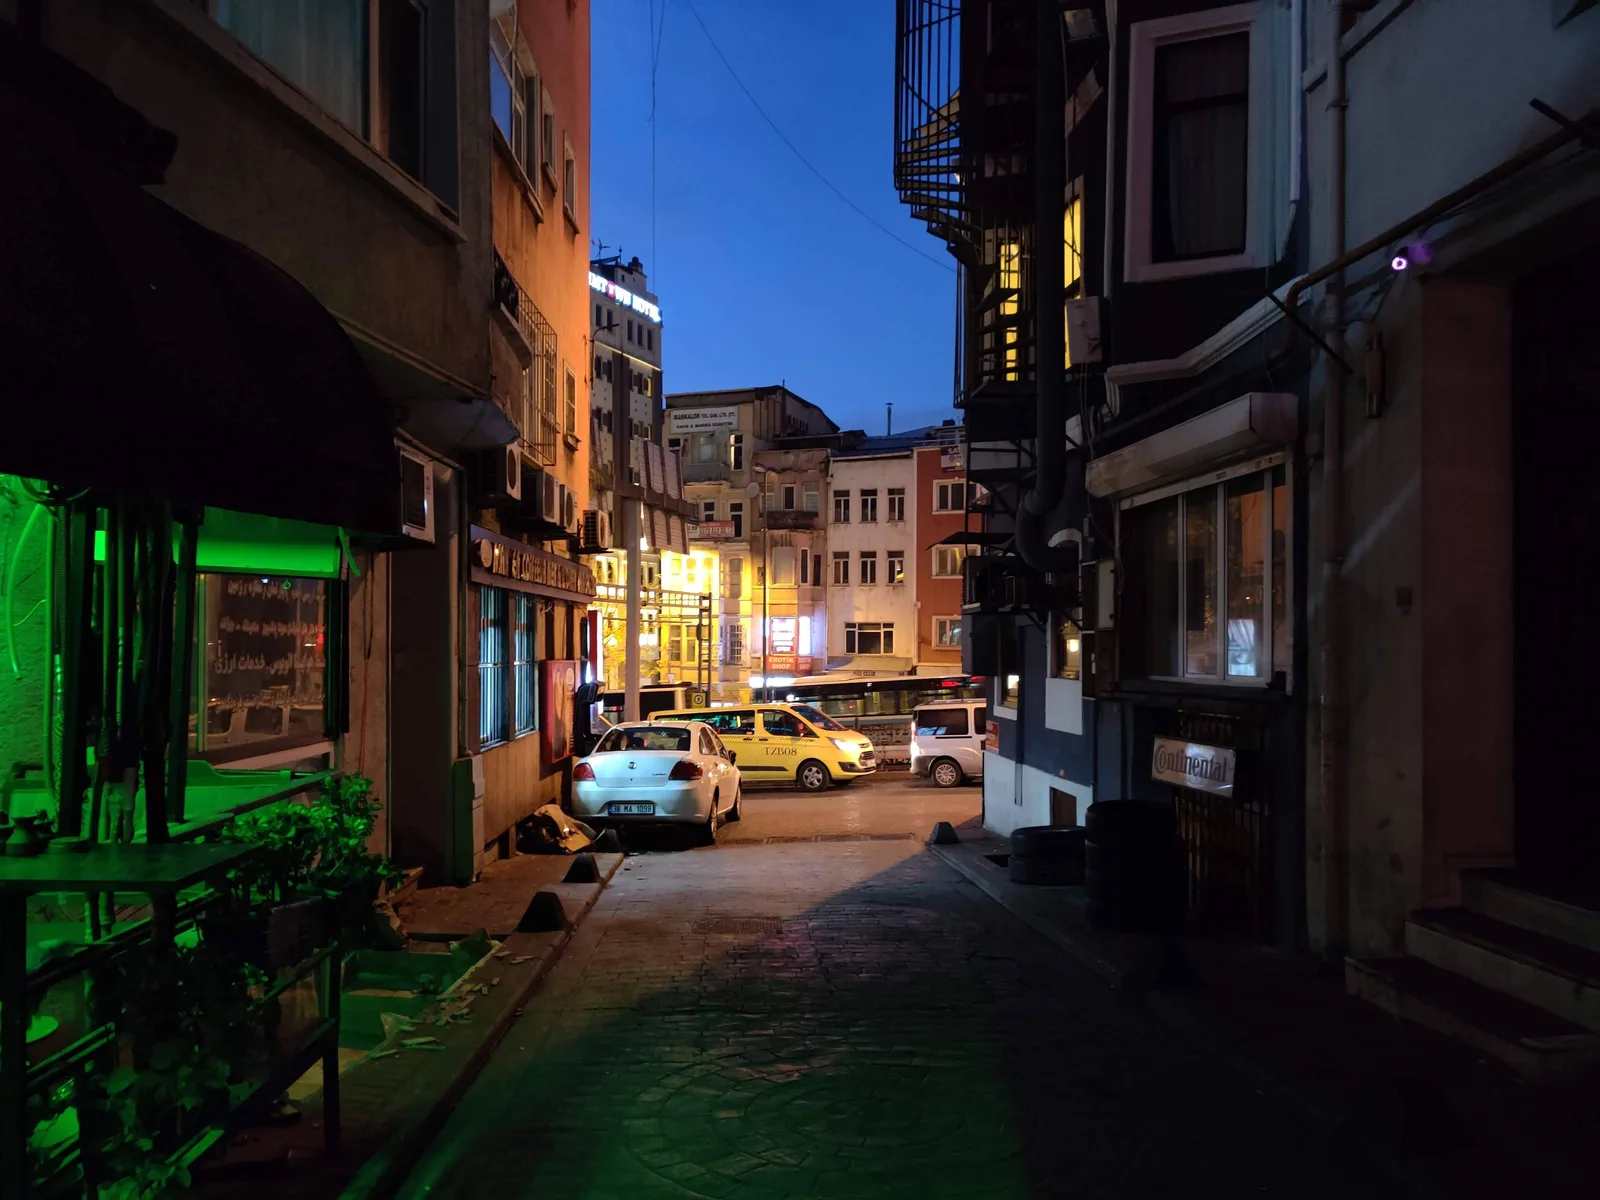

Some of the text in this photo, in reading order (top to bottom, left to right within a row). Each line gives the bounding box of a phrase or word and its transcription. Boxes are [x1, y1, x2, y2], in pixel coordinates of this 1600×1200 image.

[763, 746, 798, 756] TZB08
[1153, 744, 1228, 783] Continental
[612, 804, 652, 813] 38 MA 1098
